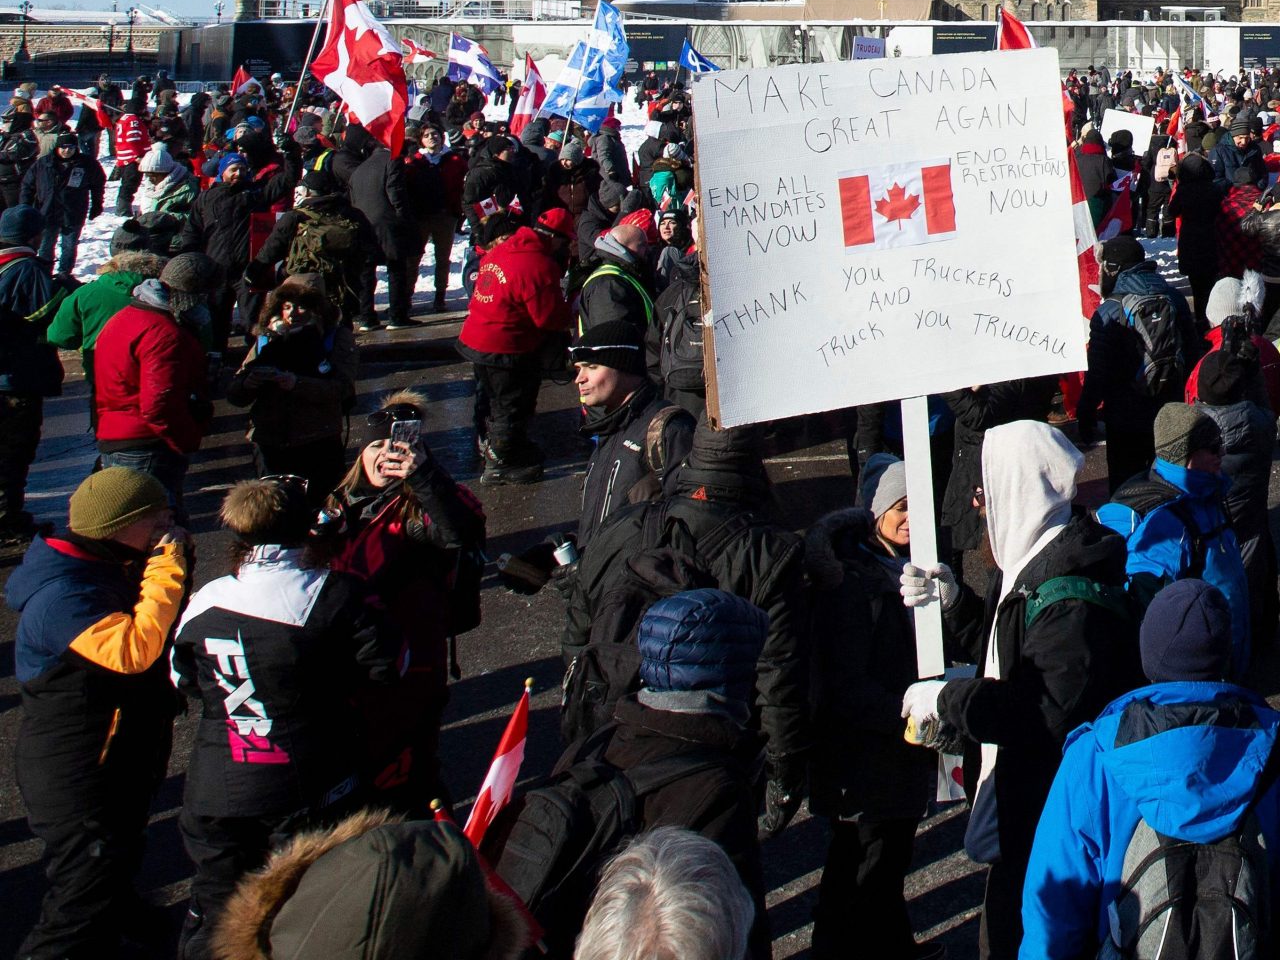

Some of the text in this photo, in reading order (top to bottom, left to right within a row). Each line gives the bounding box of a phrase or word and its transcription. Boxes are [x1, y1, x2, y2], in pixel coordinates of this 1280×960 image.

[713, 66, 998, 119] MAKE CANADA
[804, 97, 1028, 154] GREAT AGAIN
[957, 144, 1056, 167] END ALL
[961, 158, 1068, 186] RESTRICTIONS
[708, 174, 817, 209] END ALL
[722, 191, 827, 230] MANDATES
[989, 188, 1050, 216] NOW
[746, 218, 818, 257] NOW
[715, 257, 1015, 339] THANK YOU TRUCKERS
[868, 285, 911, 313] AND
[816, 308, 1069, 369] TRUCK YOU TRUDEAU
